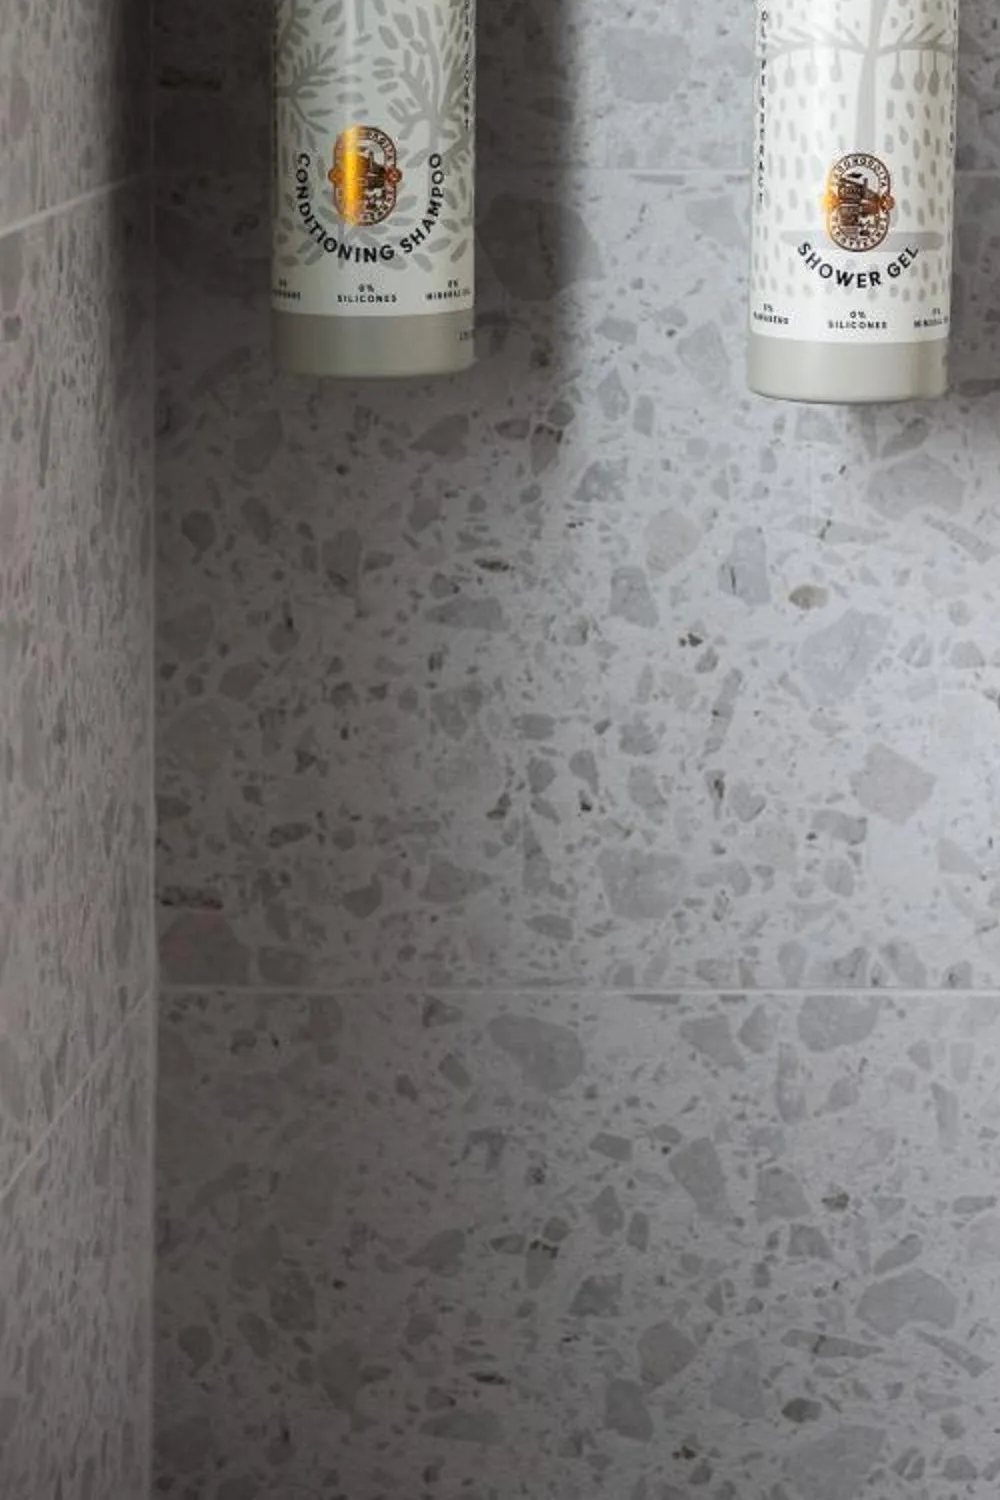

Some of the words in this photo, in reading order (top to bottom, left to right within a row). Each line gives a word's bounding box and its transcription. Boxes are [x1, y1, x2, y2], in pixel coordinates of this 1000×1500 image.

[295, 153, 395, 263] CONDITIONING
[400, 153, 445, 253] SHAMPOO
[797, 241, 882, 289] SHOWER
[887, 245, 919, 278] GEL
